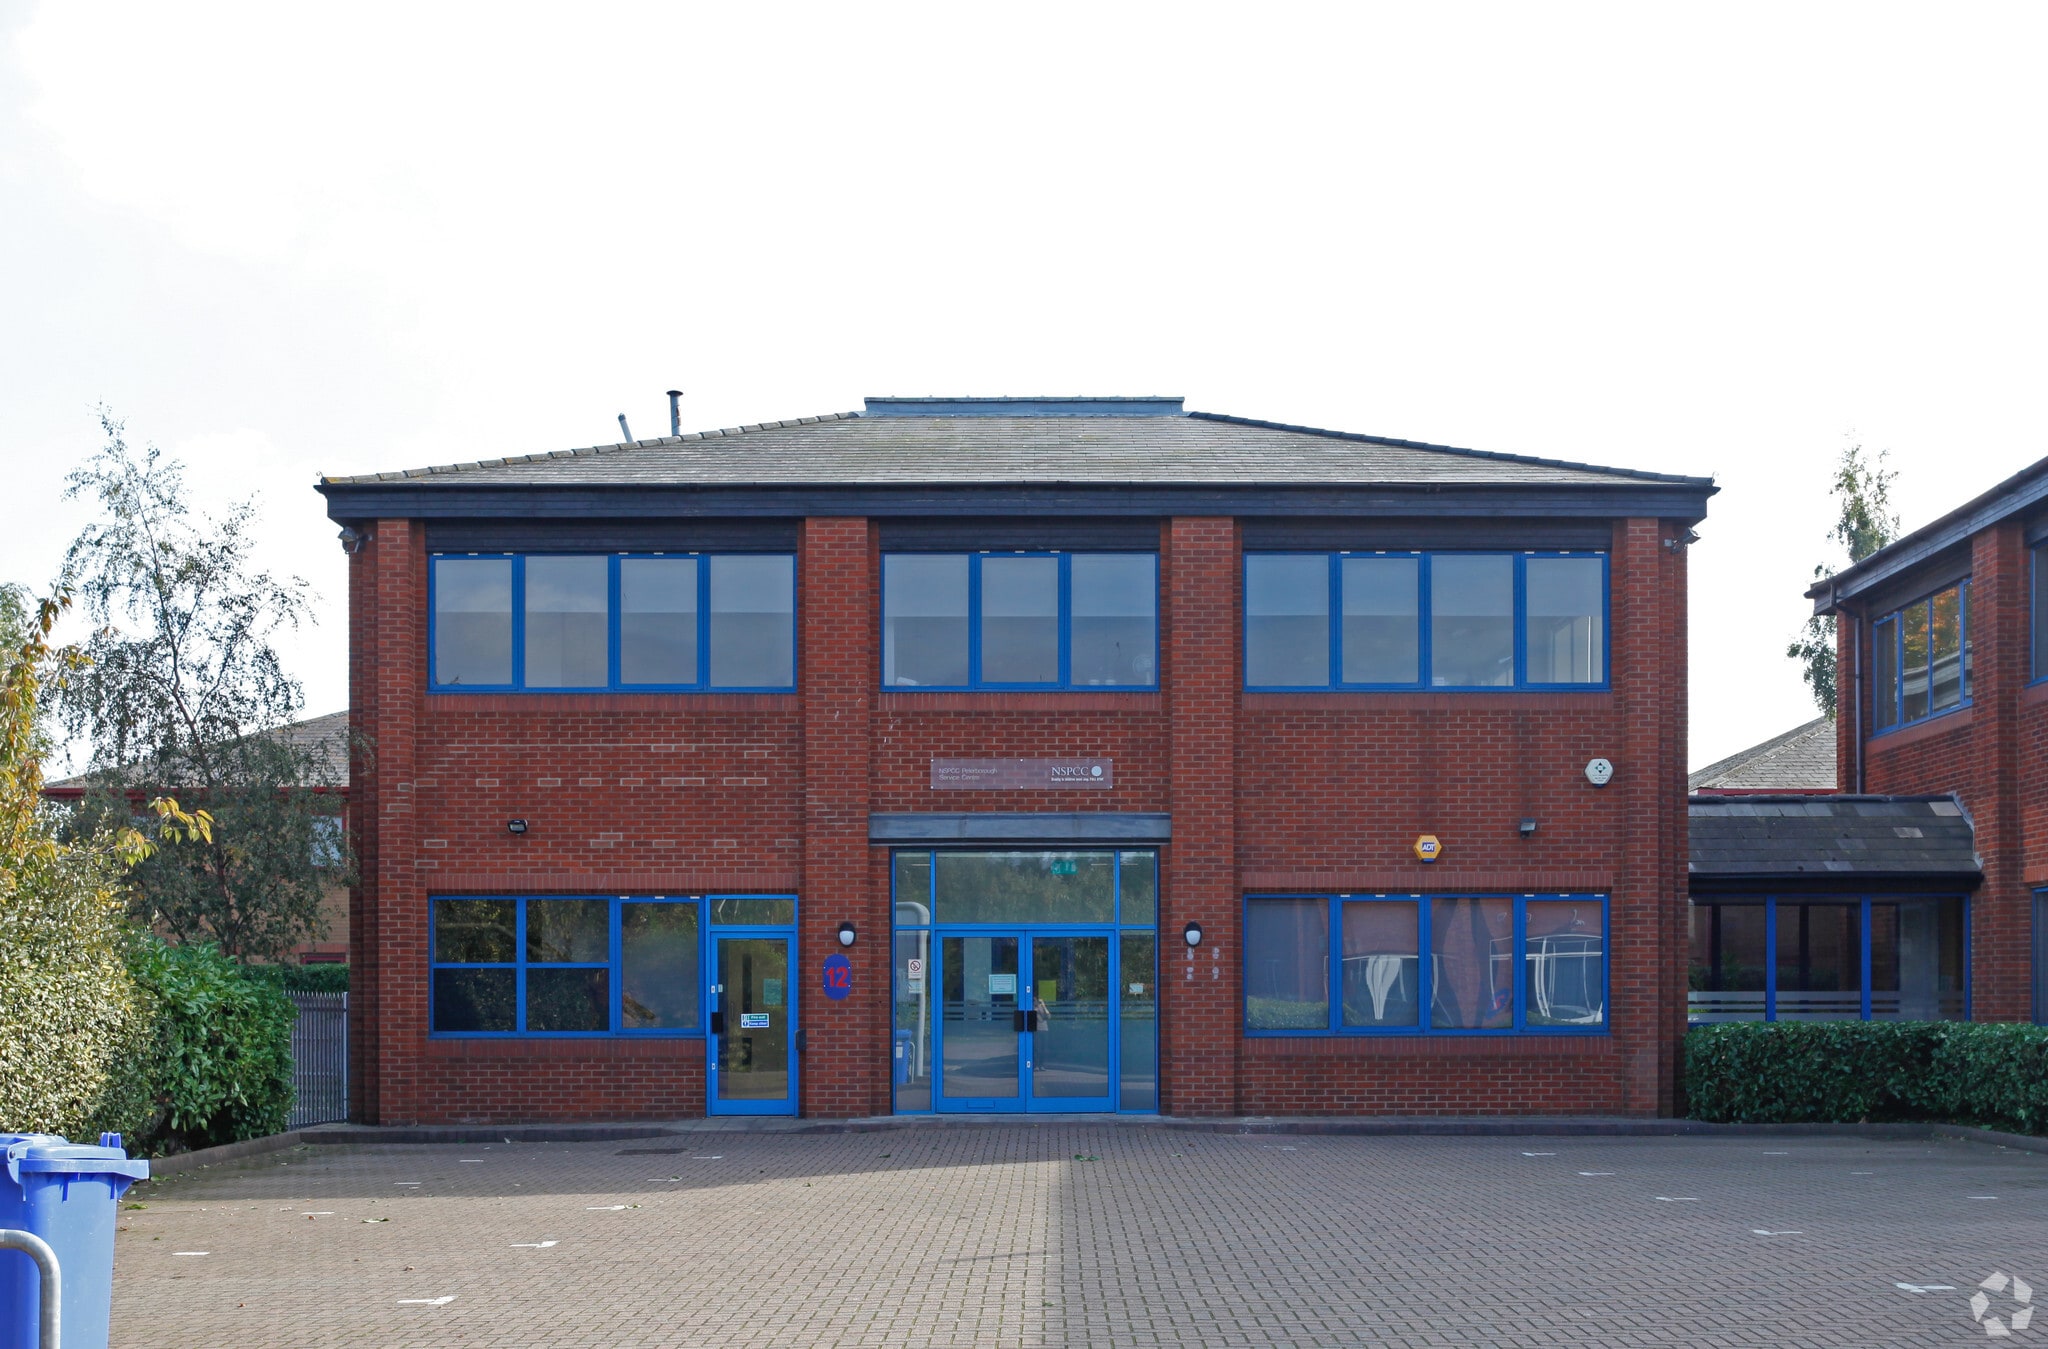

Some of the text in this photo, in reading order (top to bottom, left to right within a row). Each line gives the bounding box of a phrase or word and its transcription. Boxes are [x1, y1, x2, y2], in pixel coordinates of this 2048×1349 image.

[1051, 766, 1089, 776] NSPCC
[1421, 843, 1435, 851] ADT
[826, 966, 849, 988] 12
